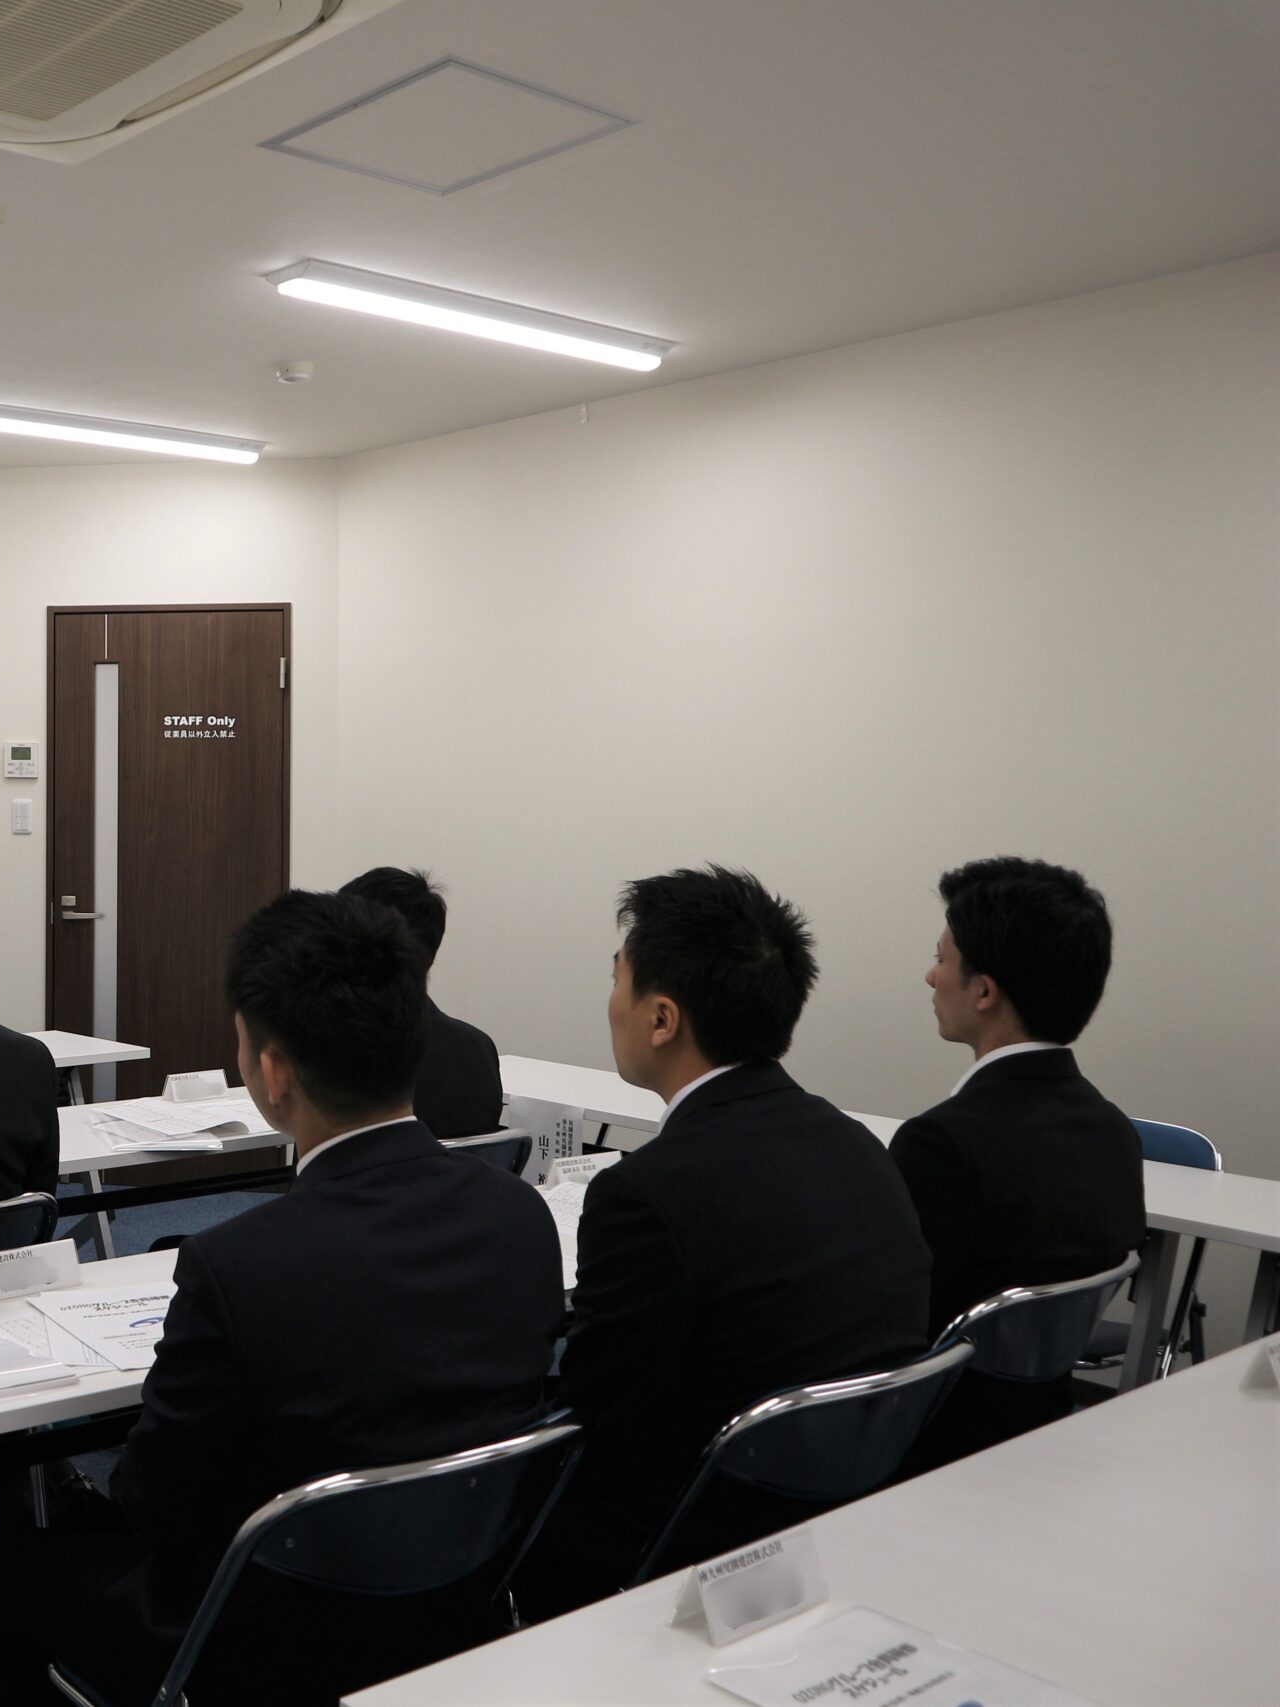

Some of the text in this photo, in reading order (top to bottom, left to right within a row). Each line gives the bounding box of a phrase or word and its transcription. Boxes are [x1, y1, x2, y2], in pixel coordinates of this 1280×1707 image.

[164, 715, 236, 728] STAFF Only
[164, 730, 236, 738] 従業員以外立入禁止
